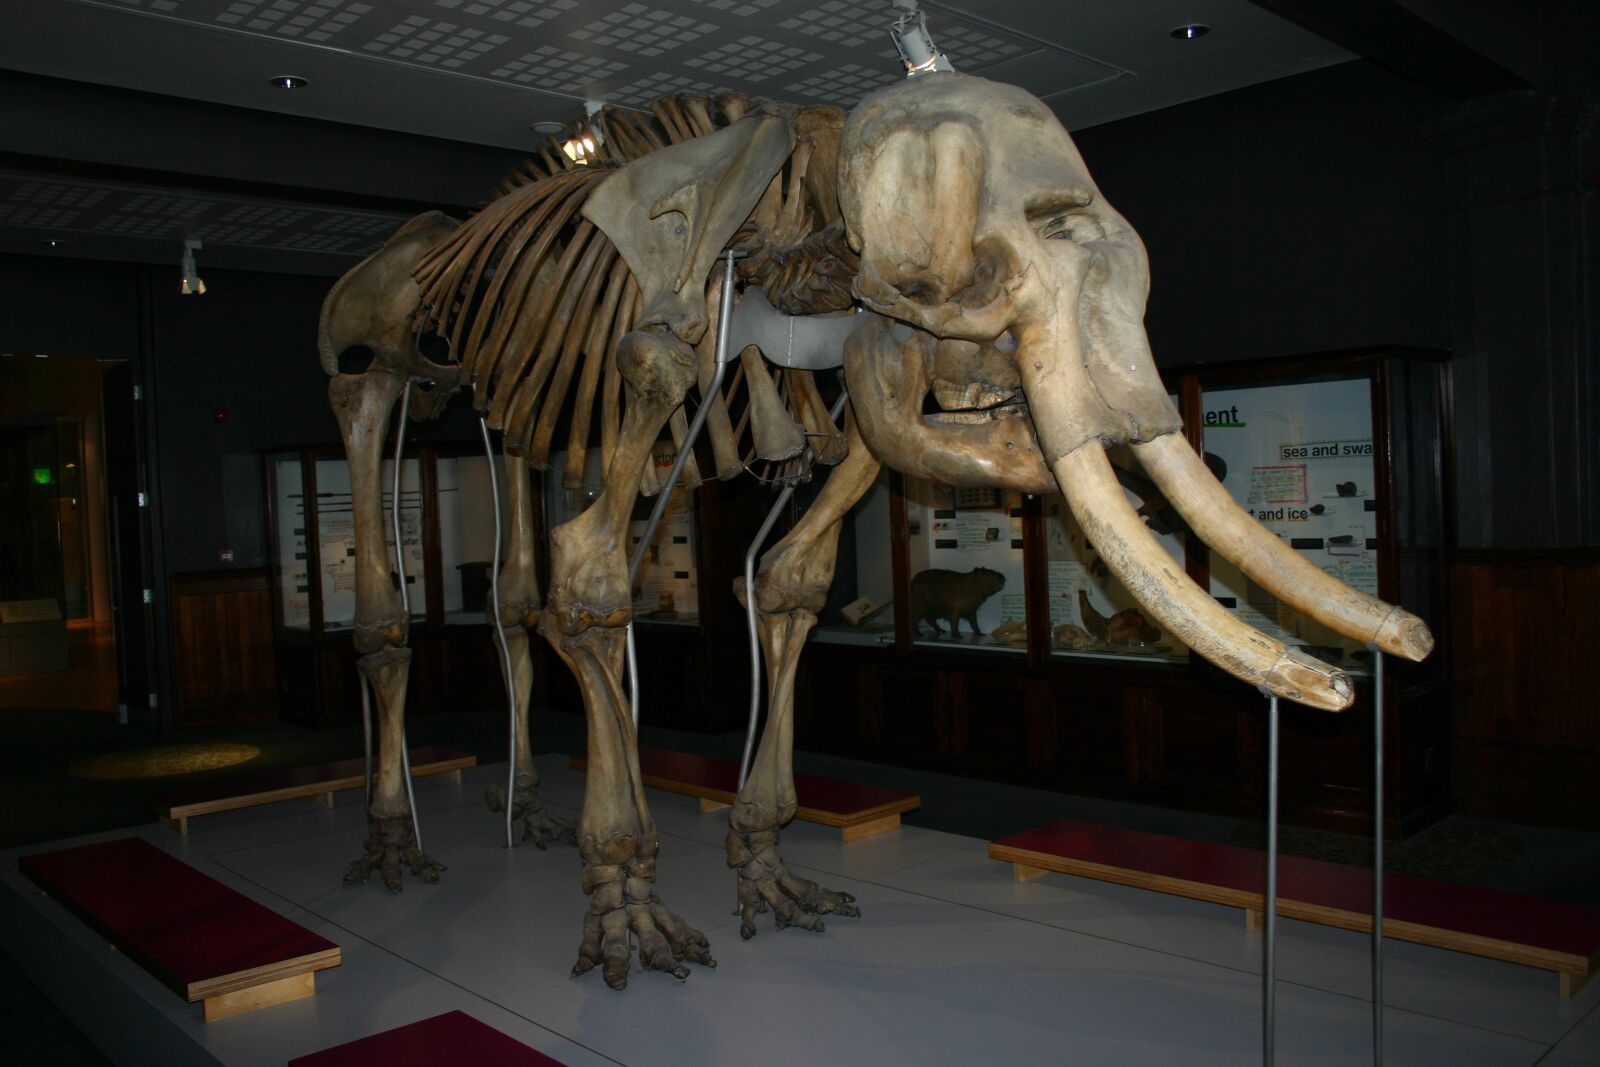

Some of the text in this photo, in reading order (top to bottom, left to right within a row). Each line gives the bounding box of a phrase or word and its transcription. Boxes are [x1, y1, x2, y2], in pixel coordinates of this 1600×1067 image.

[1202, 406, 1239, 424] ent
[1284, 443, 1372, 458] sea and swa
[1259, 507, 1284, 520] and
[1288, 507, 1308, 520] ice
